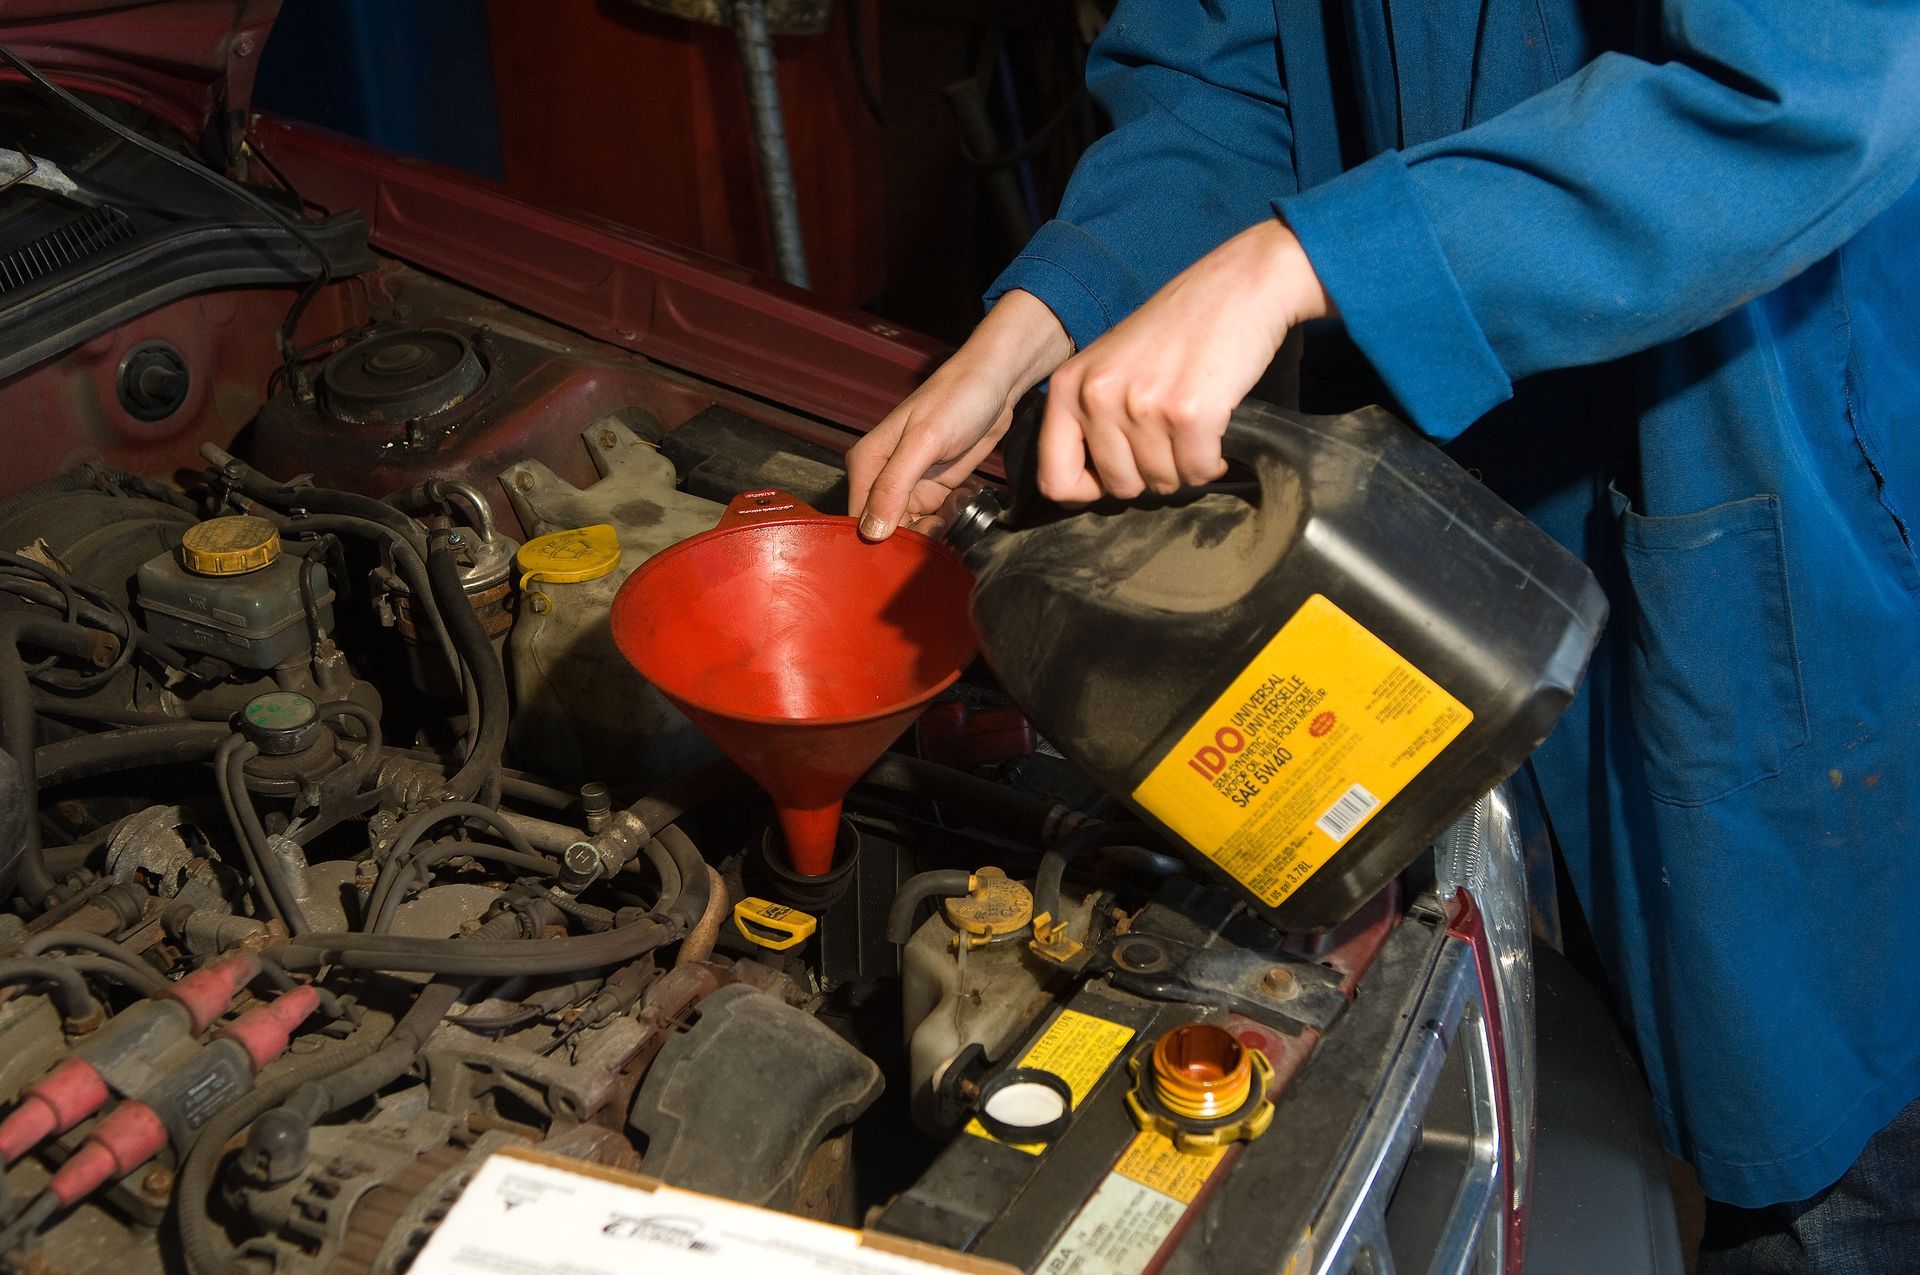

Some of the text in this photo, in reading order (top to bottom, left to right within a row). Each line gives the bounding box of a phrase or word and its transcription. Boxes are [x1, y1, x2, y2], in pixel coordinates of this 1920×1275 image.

[1230, 674, 1285, 726] UNIVERSAL
[1243, 675, 1304, 736] UNIVERSELLE
[1188, 727, 1245, 781] IDO
[1213, 736, 1266, 790] SEMI-SYNTHETIC
[1221, 770, 1249, 798] MOTOR
[1246, 760, 1261, 772] OIL
[1258, 737, 1281, 759] HUILE
[1276, 718, 1298, 739] POUR
[1296, 688, 1327, 720] MOTEUR
[1232, 780, 1260, 808] SAE
[1254, 748, 1292, 784] 5W40
[576, 851, 590, 864] H
[1270, 890, 1282, 900] US
[1280, 880, 1291, 894] gal
[1287, 861, 1312, 883] 3.78L
[1030, 1014, 1074, 1062] ATTENTION
